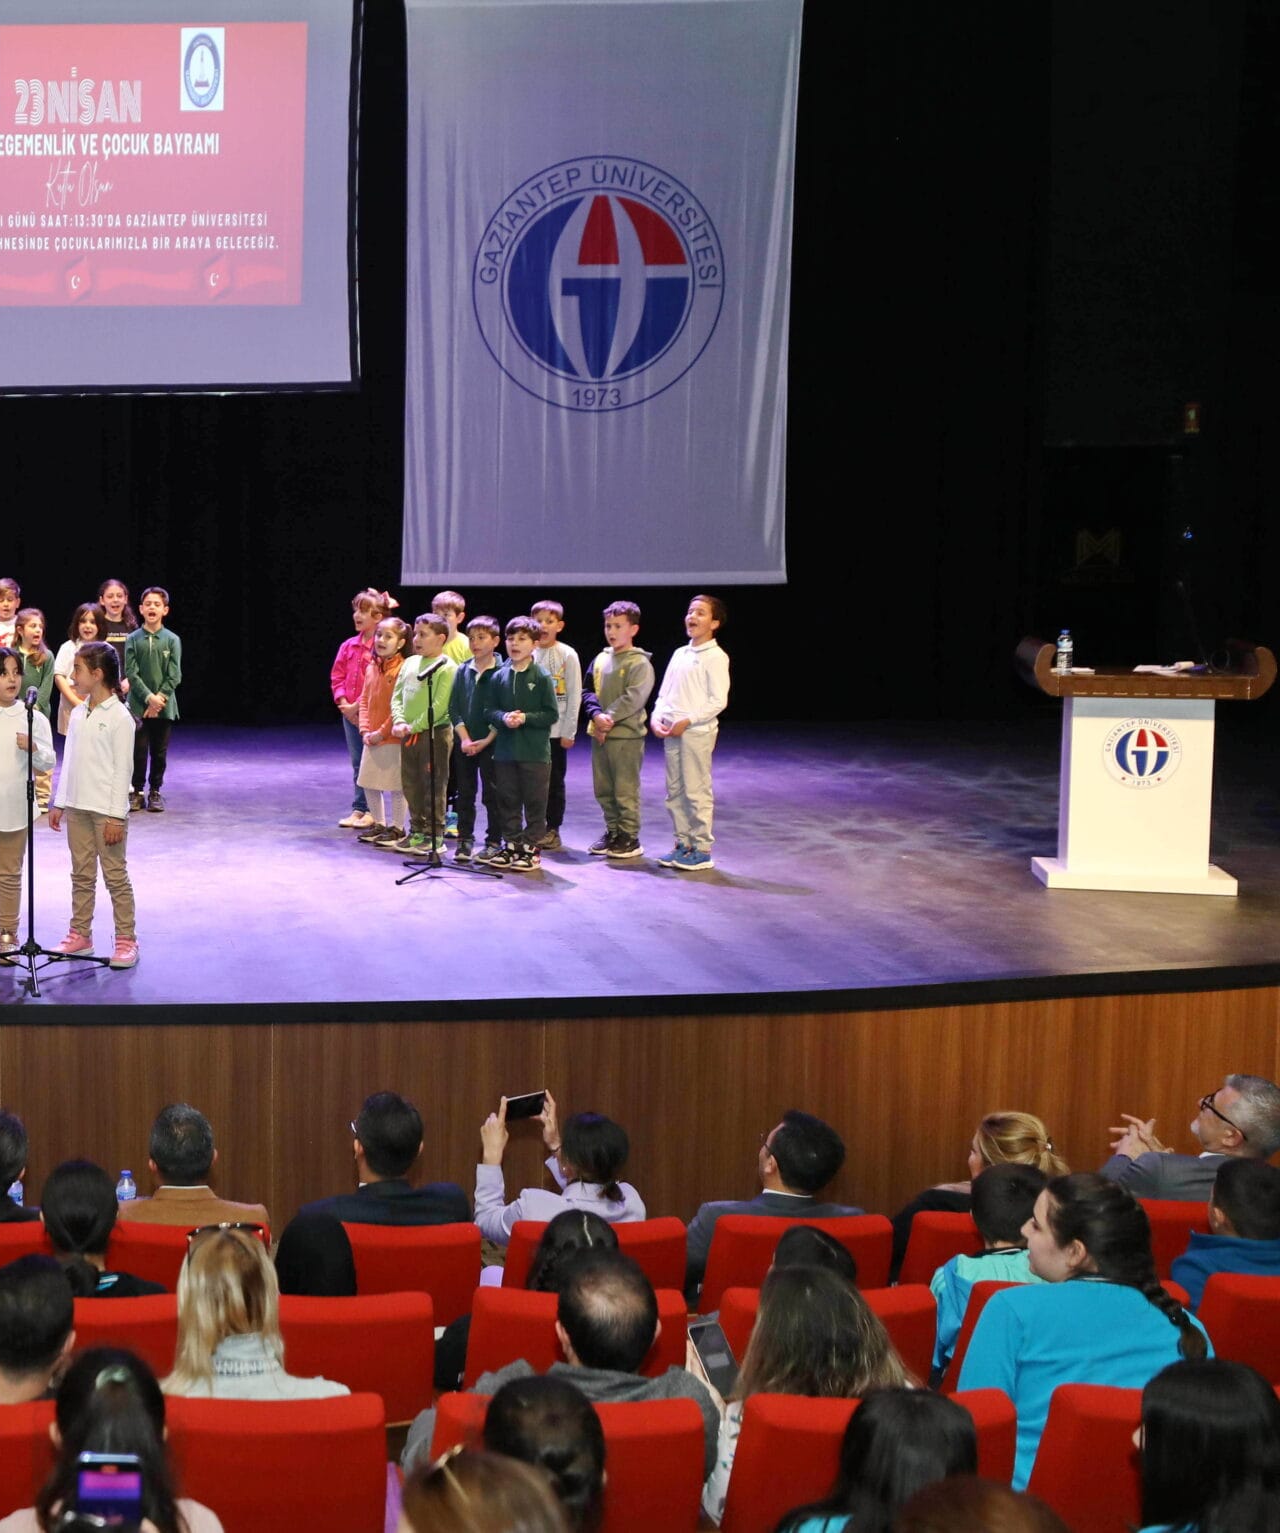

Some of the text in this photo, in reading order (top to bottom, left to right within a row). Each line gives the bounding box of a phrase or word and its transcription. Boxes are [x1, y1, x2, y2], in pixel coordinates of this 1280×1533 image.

[80, 133, 98, 156] VE
[102, 133, 150, 161] ÇOCUK
[153, 132, 220, 156] BAYRAMI
[8, 211, 36, 228] GÜNÜ
[126, 211, 187, 227] GAZİANTEP
[191, 211, 268, 227] ÜNİVERSİTESİ
[479, 160, 721, 289] GAZİANTEP ÜNİVERSİTESİ
[54, 236, 148, 252] ÇOCUKLARIMIZLA
[152, 234, 171, 249] BİR
[175, 236, 211, 249] ARAYA
[215, 234, 280, 250] GELECEĞİZ.
[571, 387, 621, 407] 1973
